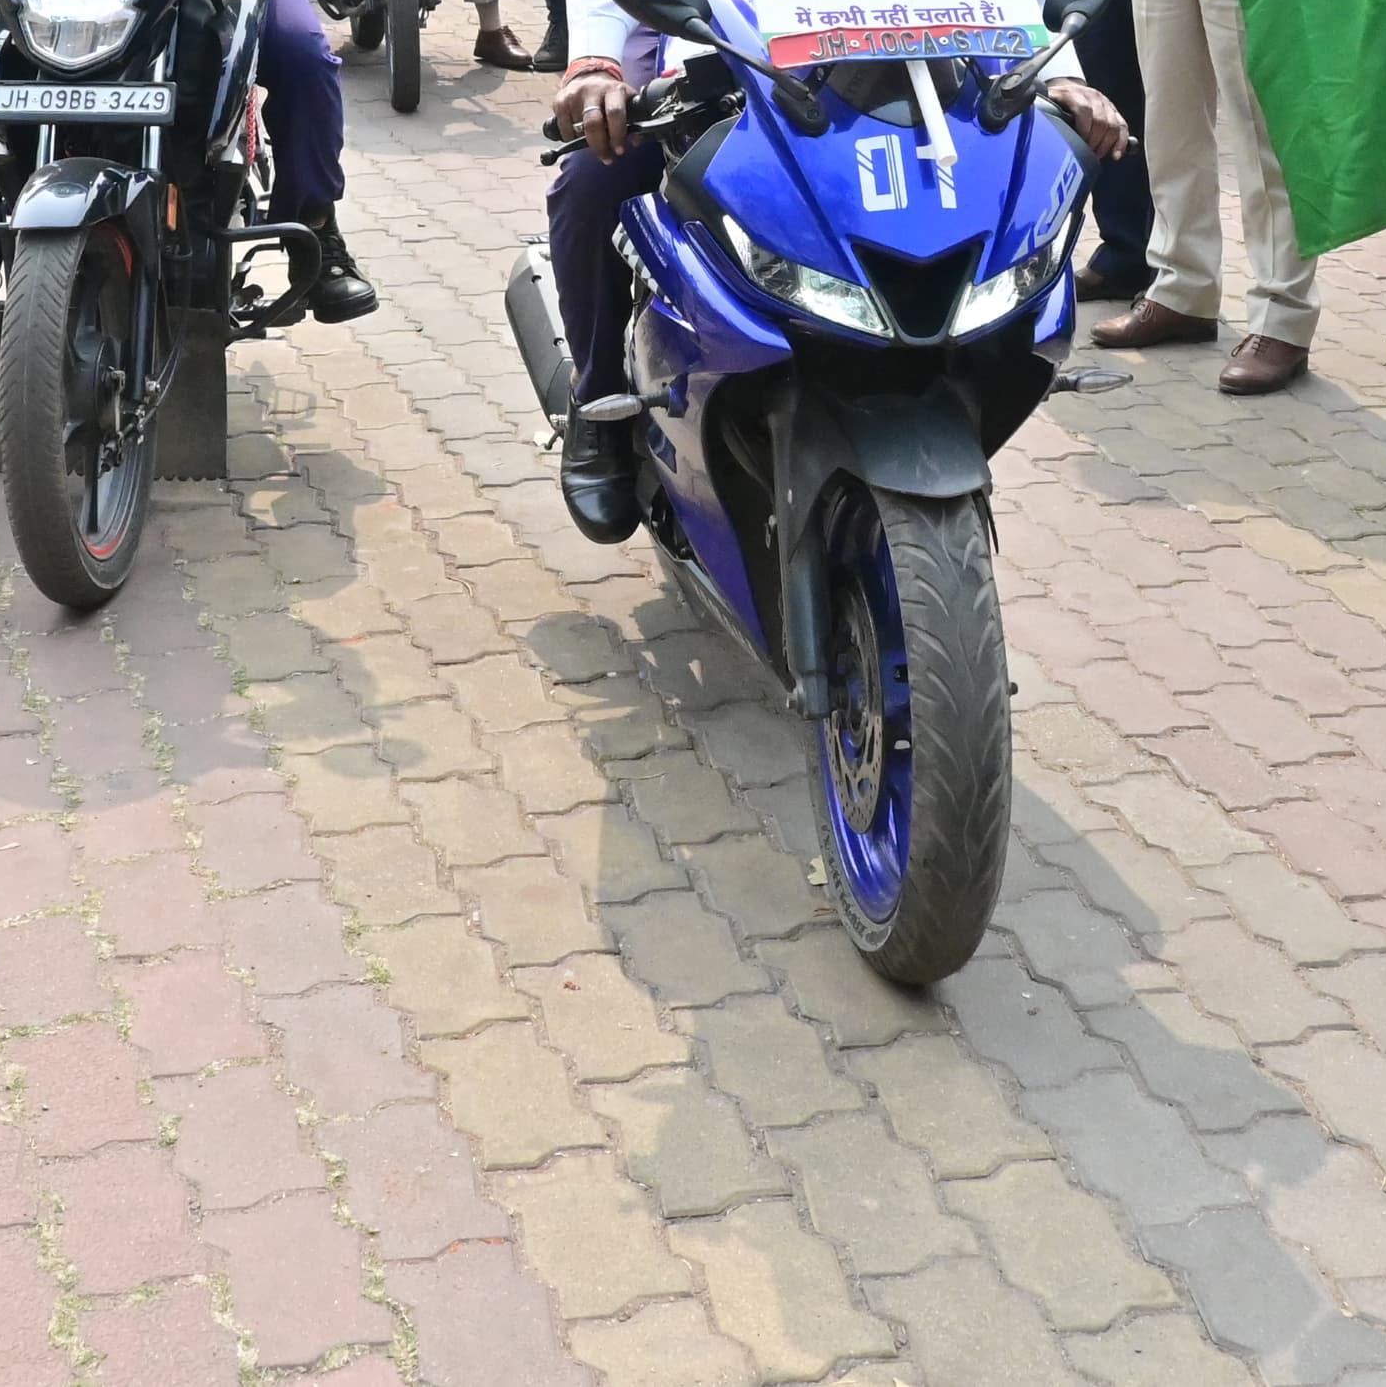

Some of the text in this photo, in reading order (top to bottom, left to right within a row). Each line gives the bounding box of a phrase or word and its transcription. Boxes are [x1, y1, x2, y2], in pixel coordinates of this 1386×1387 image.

[796, 0, 1006, 27] में कभी नहीं चलाते हैं।
